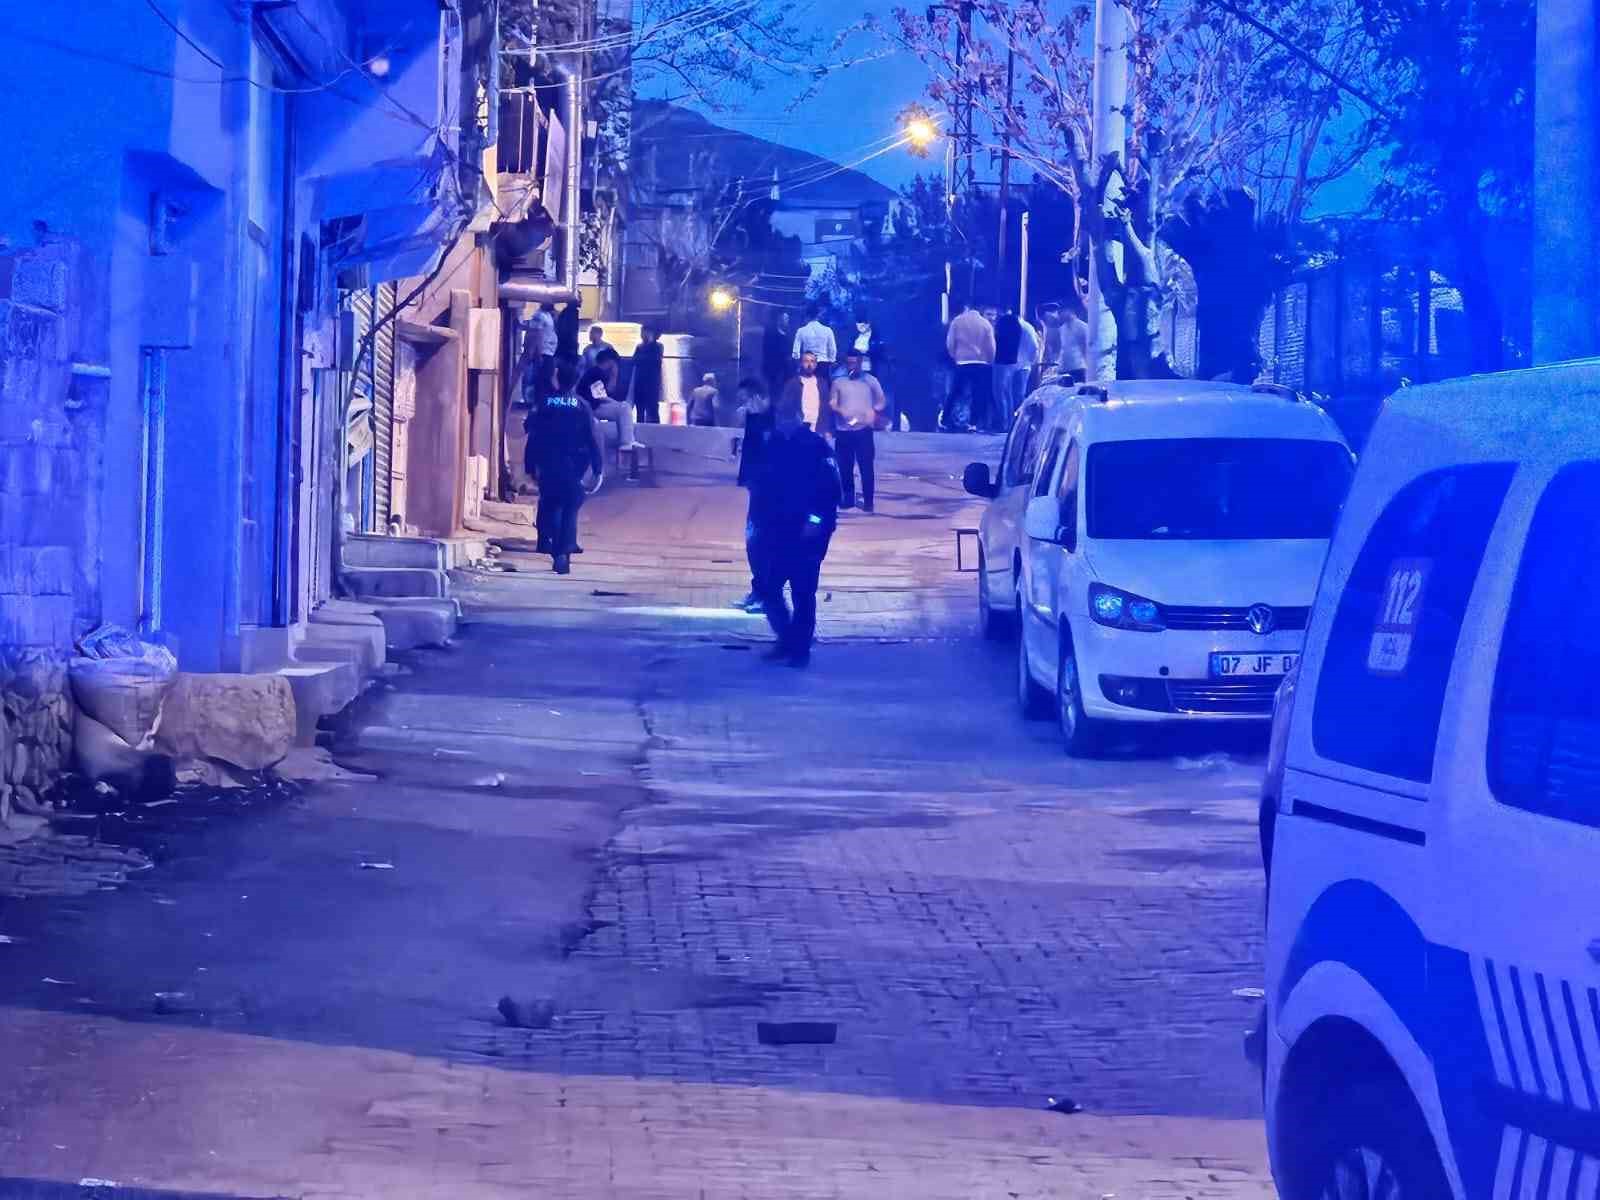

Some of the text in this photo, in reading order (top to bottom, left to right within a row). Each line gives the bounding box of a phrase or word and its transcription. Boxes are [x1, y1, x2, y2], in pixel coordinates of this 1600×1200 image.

[1383, 568, 1422, 625] 112
[1221, 656, 1241, 674] 07
[1252, 656, 1273, 673] JF
